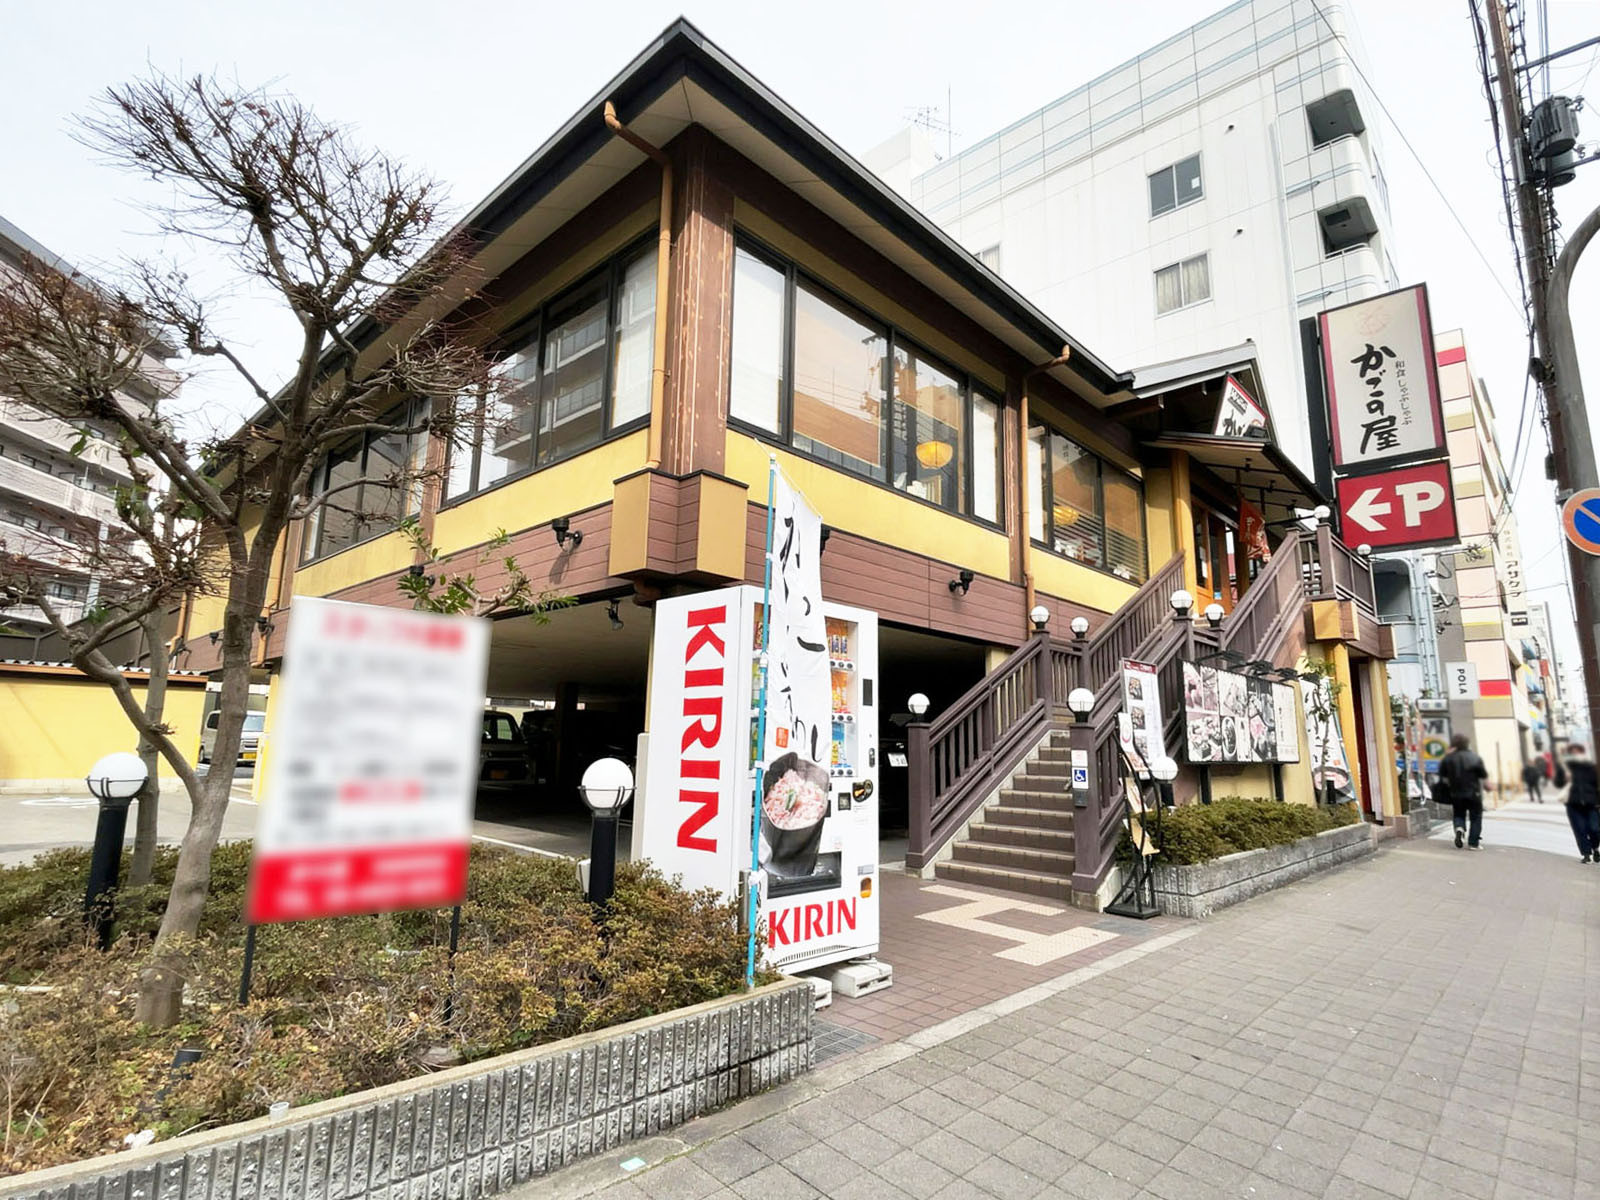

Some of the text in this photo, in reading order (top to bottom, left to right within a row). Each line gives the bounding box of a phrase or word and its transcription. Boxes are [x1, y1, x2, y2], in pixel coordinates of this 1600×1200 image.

[1350, 343, 1400, 454] かごの屋
[1395, 481, 1446, 527] P
[1457, 668, 1468, 695] POLA
[676, 605, 727, 853] KIRIN
[768, 897, 858, 949] KIRIN
